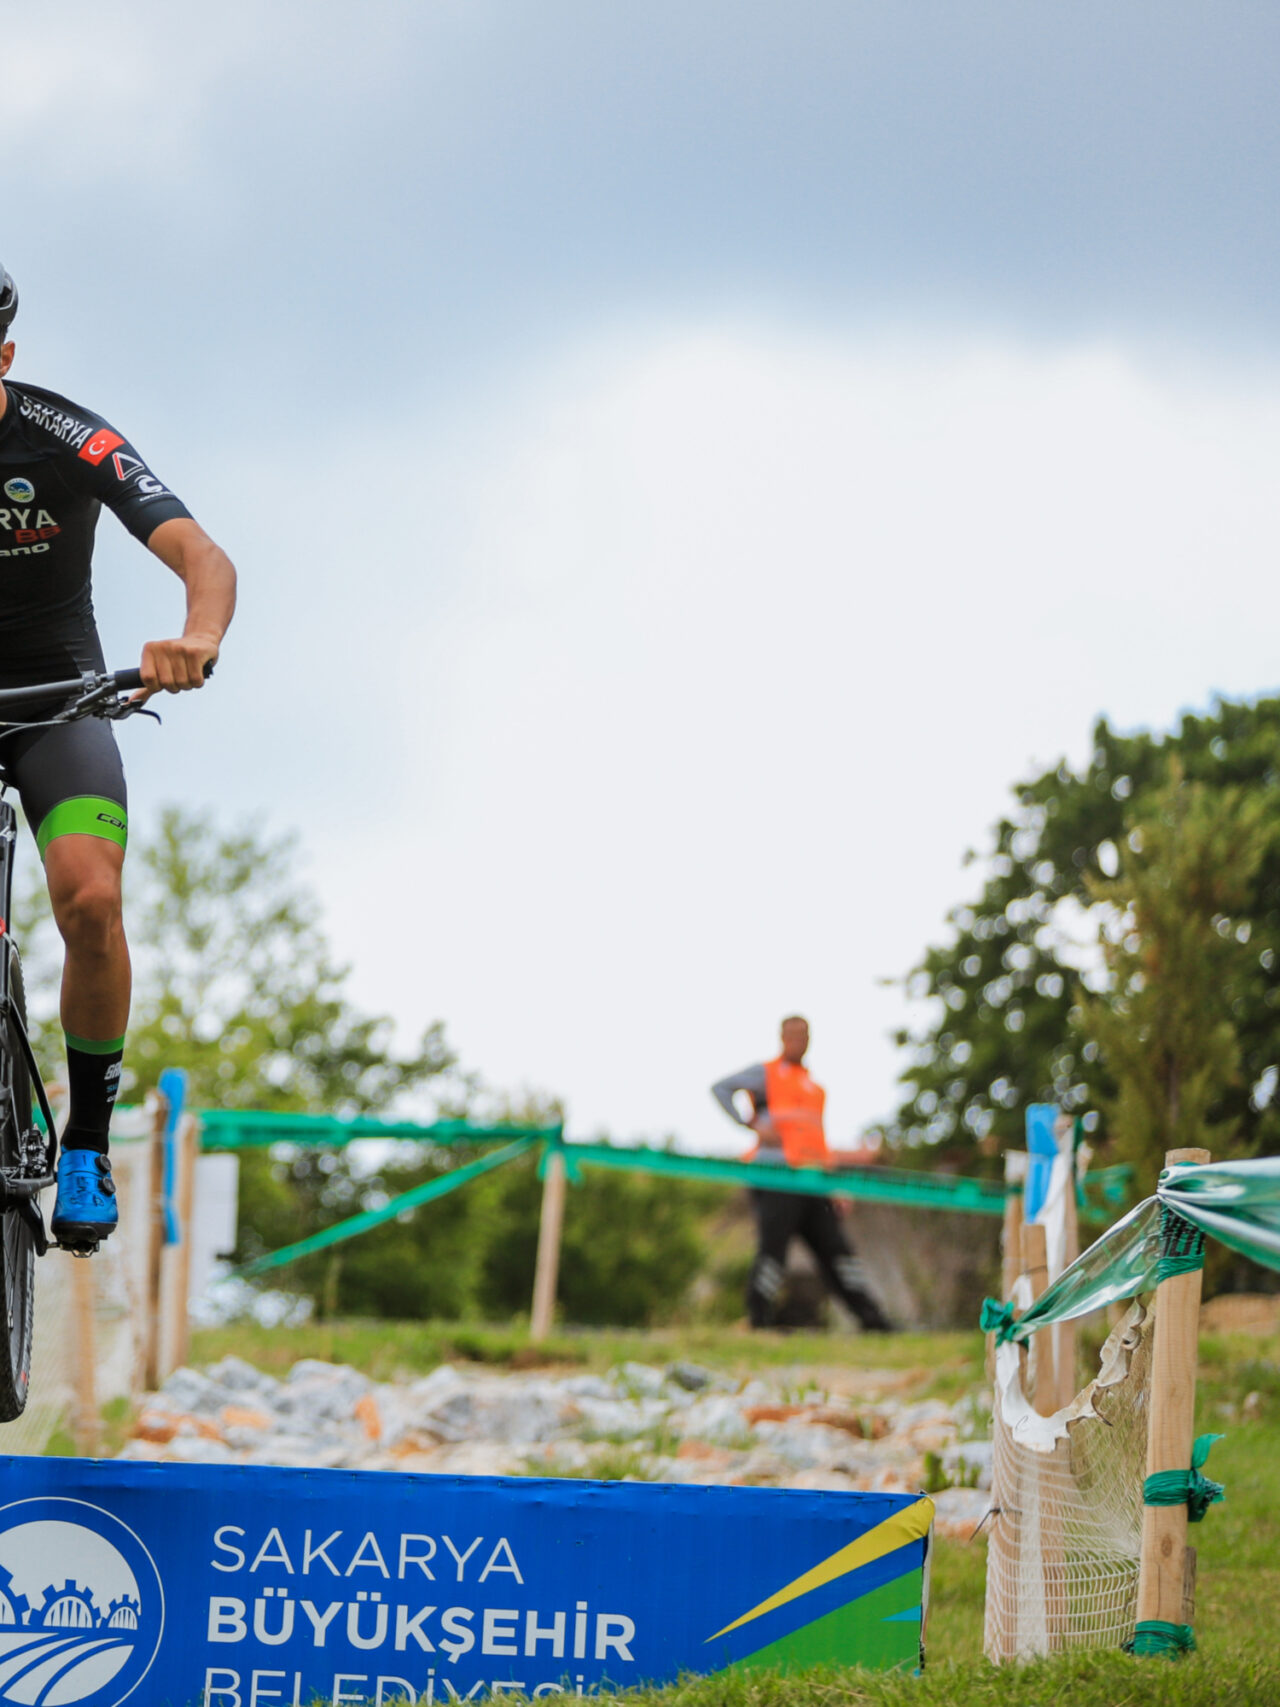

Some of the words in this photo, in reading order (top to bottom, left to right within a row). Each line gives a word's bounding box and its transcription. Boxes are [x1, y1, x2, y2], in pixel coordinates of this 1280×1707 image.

[20, 396, 93, 449] SAKARYA
[15, 526, 62, 543] BB
[210, 1525, 524, 1584] SAKARYA
[207, 1587, 636, 1664] BÜYÜKŞEHİR
